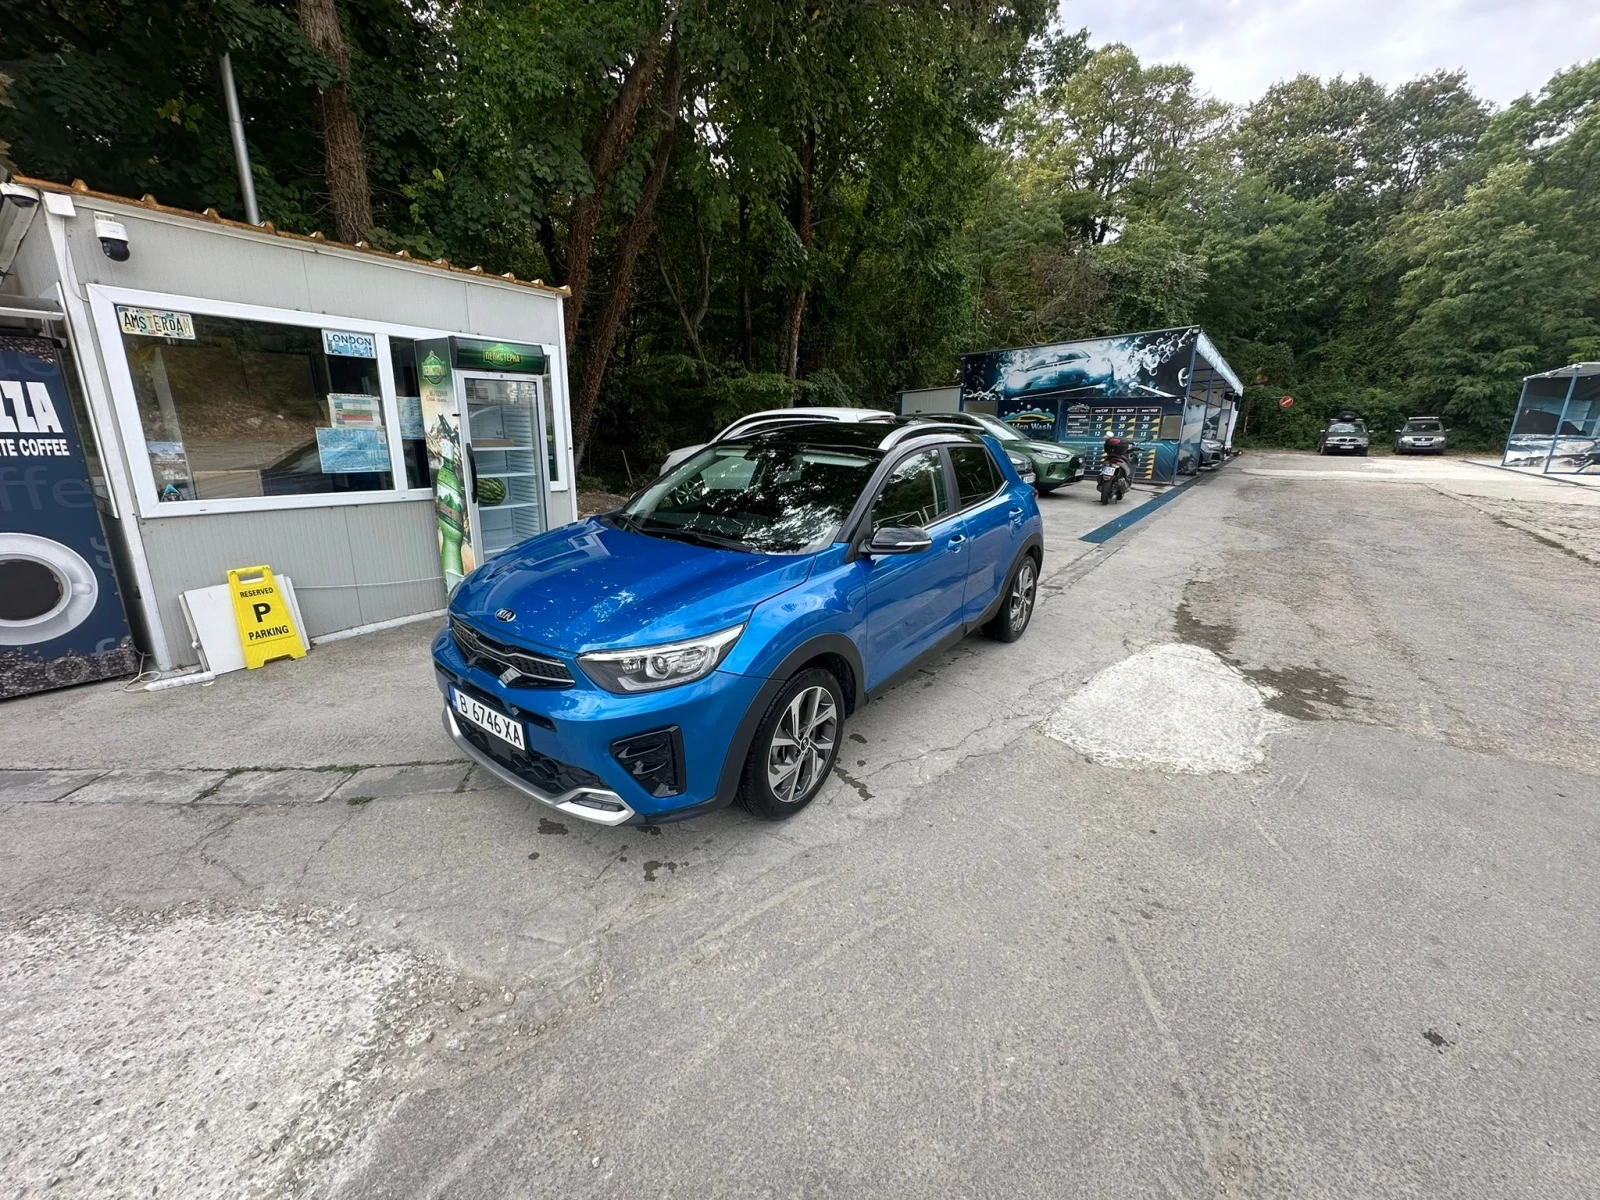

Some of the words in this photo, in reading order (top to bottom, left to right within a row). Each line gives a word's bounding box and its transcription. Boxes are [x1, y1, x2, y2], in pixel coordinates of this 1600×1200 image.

[124, 311, 192, 335] AMSTERDAM
[325, 333, 372, 346] LONDON
[0, 380, 64, 433] ZA
[1012, 422, 1029, 430] lden
[1030, 422, 1052, 430] Wash
[0, 438, 18, 457] TE
[19, 438, 70, 457] COFFEE
[239, 586, 274, 598] RESERVED
[252, 602, 271, 623] P
[495, 609, 512, 621] KIA
[248, 625, 289, 641] PARKING
[459, 693, 468, 715] B
[472, 703, 502, 735] 6746
[503, 717, 522, 747] XA
